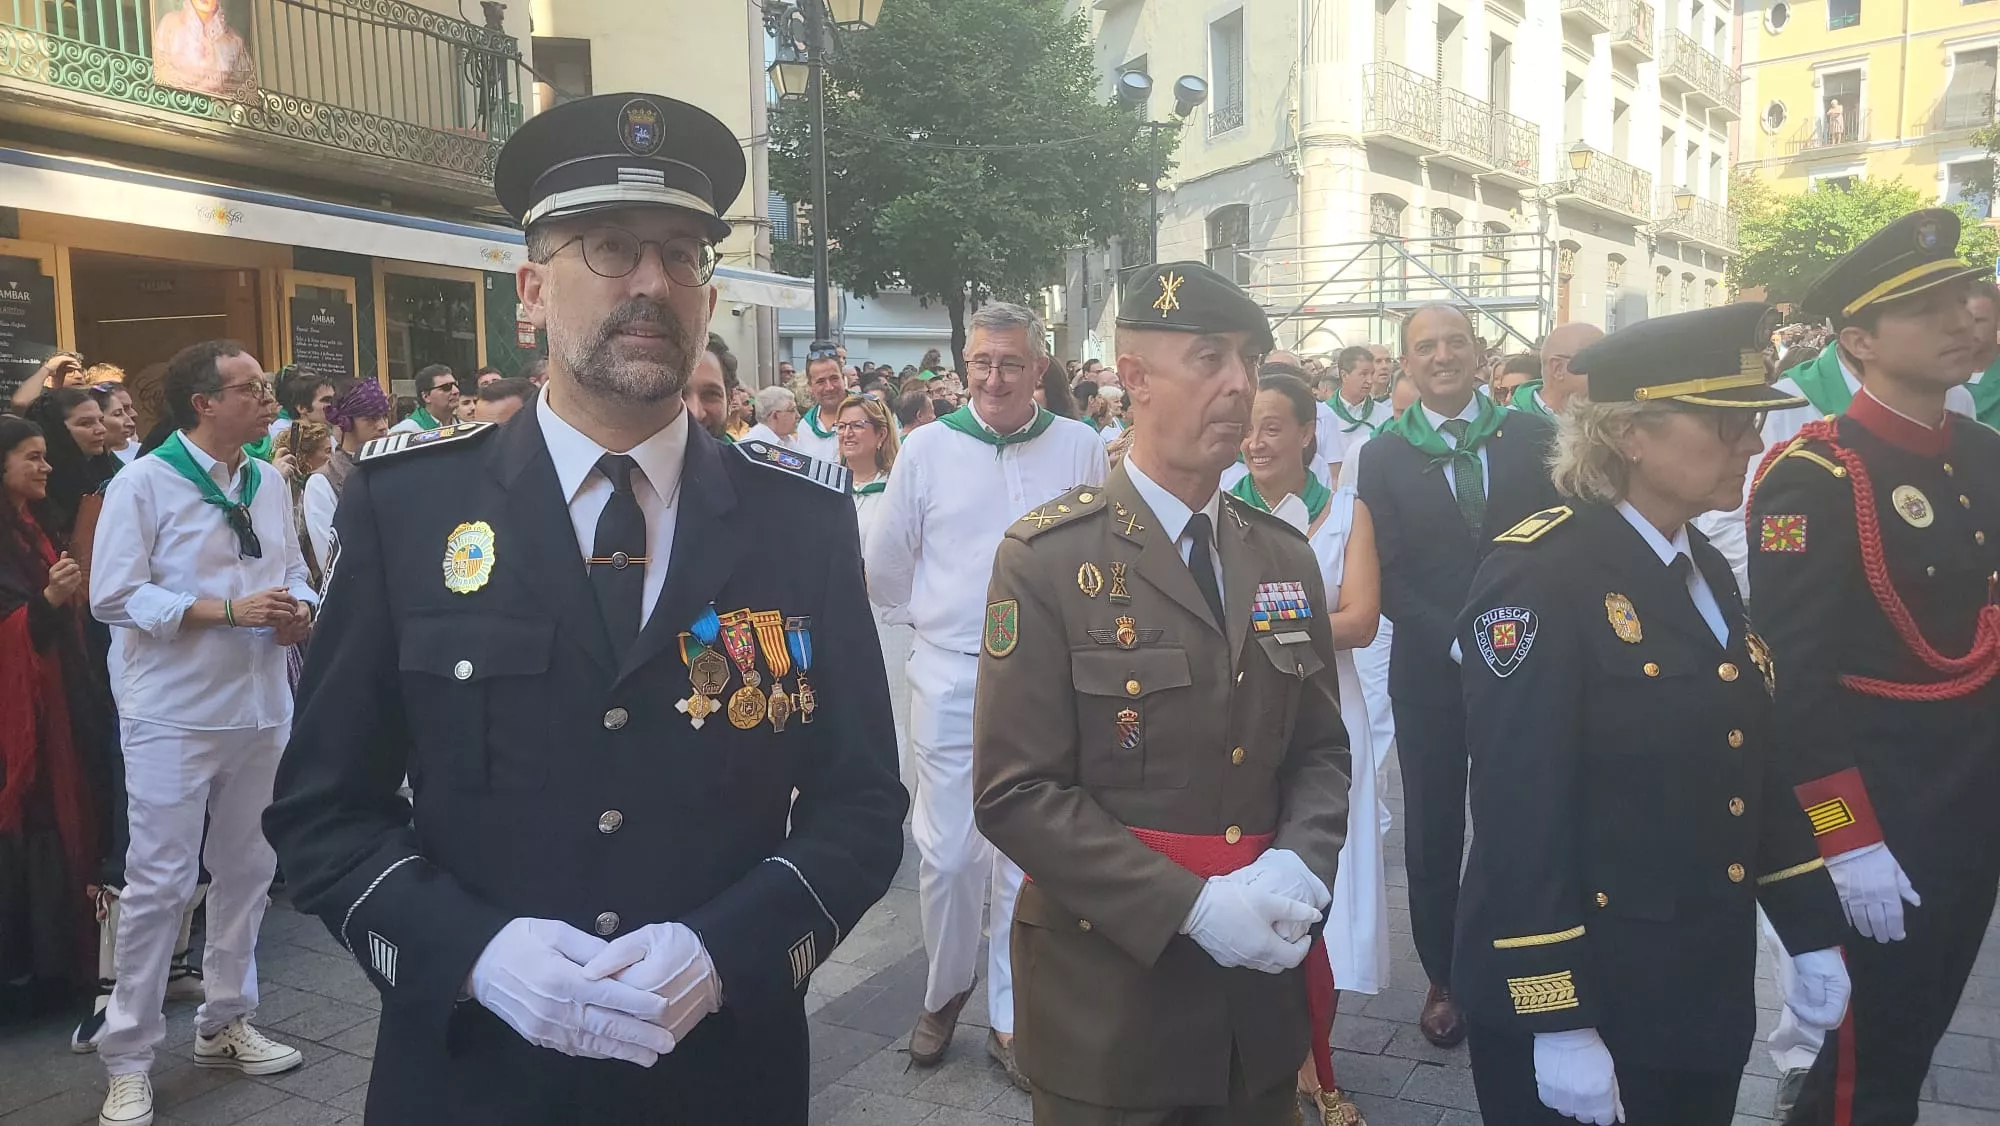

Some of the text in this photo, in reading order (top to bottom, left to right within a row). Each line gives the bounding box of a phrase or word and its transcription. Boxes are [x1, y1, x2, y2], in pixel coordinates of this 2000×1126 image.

[1481, 608, 1530, 626] HUESCA
[1478, 631, 1534, 664] POLICIA LOCAL
